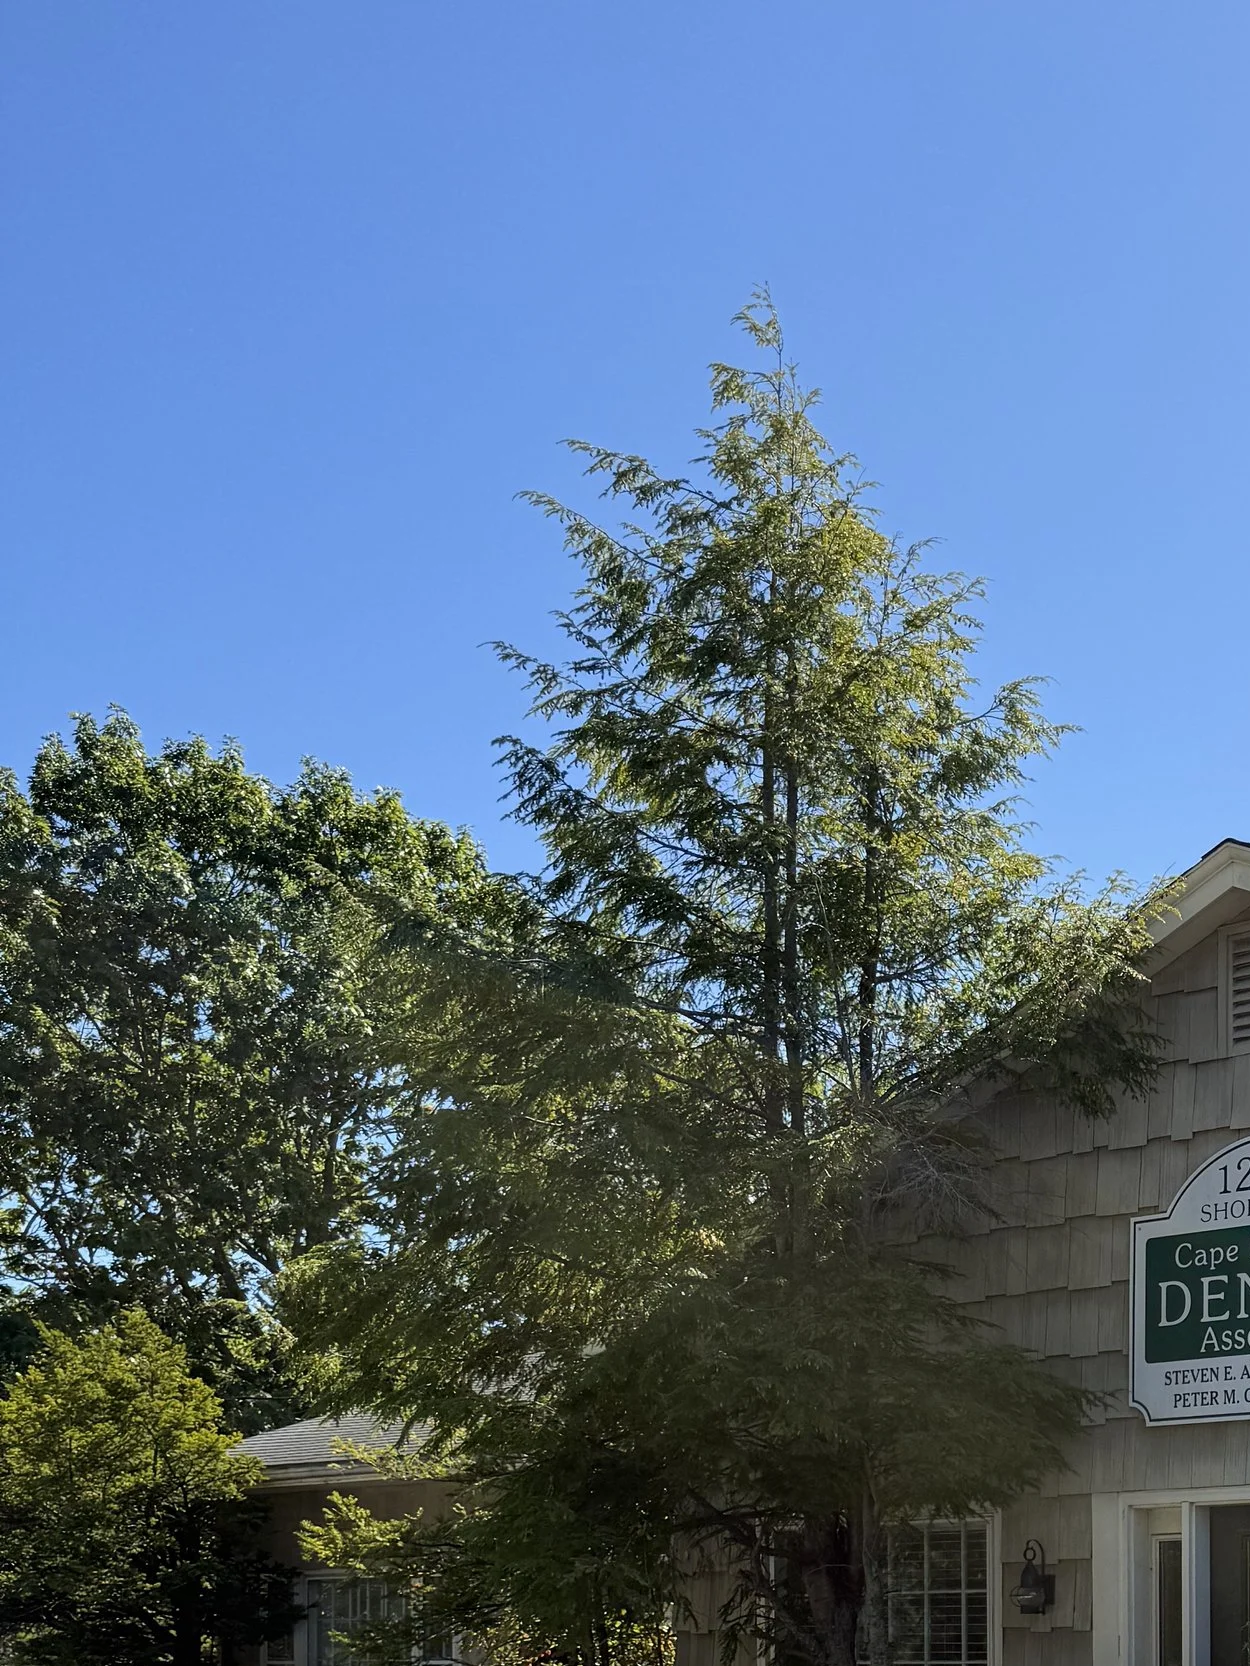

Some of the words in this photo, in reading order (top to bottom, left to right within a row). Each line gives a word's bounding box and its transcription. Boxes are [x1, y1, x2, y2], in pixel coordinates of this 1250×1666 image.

[1175, 1244, 1239, 1270] Cape
[1164, 1367, 1219, 1386] STEVEN
[1224, 1365, 1236, 1381] E.
[1173, 1390, 1219, 1408] PETER
[1223, 1390, 1239, 1404] M.
